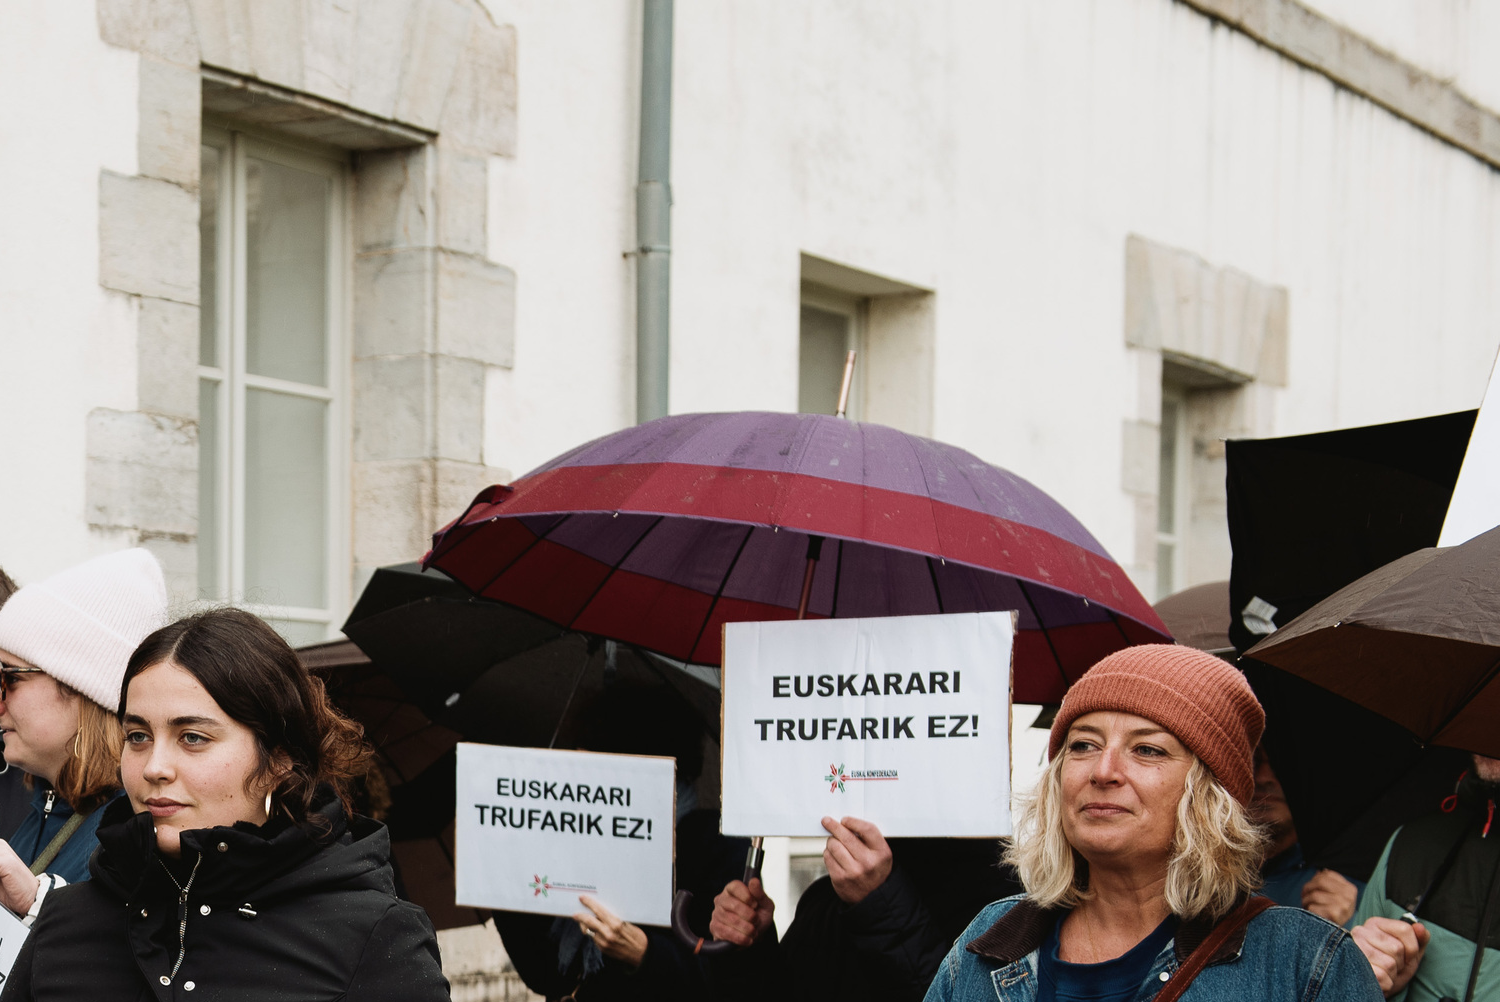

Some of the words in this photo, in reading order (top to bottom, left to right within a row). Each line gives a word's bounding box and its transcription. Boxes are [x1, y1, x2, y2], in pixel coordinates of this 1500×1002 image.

[772, 670, 962, 699] EUSKARARI
[754, 716, 916, 742] TRUFARIK
[928, 714, 979, 739] EZ!
[496, 777, 631, 807] EUSKARARI
[474, 804, 603, 837] TRUFARIK
[612, 817, 653, 841] EZ!
